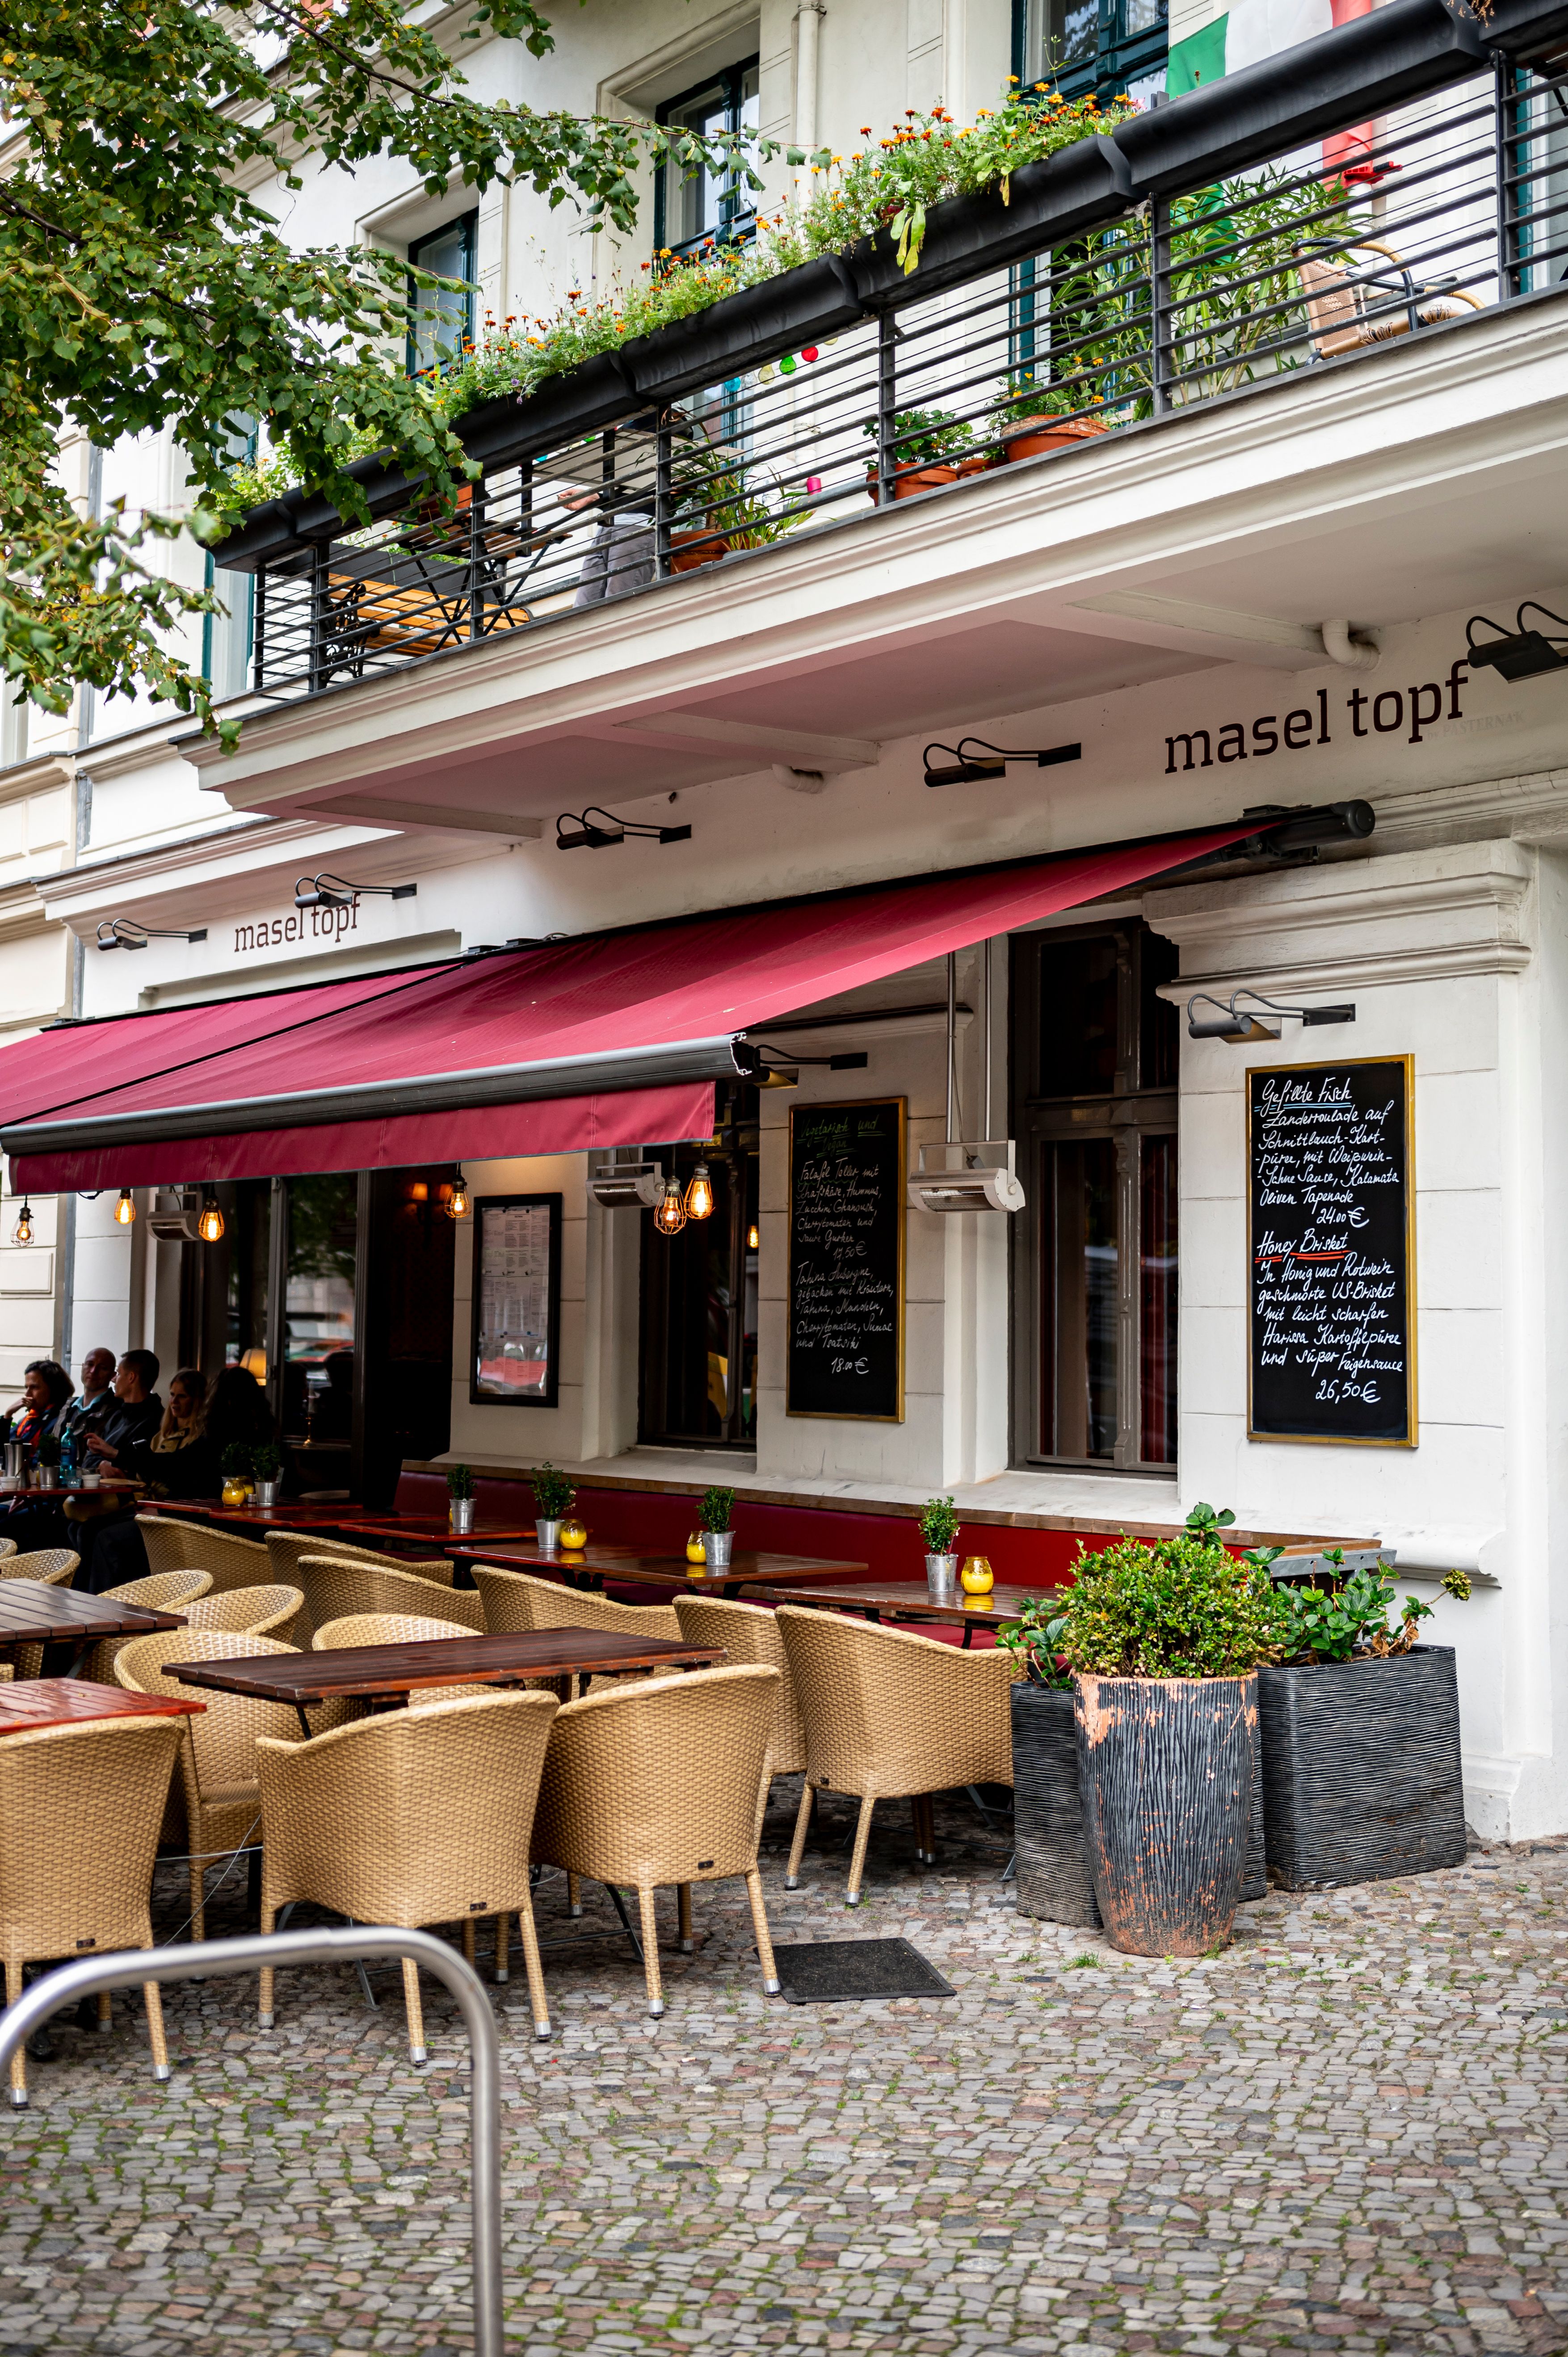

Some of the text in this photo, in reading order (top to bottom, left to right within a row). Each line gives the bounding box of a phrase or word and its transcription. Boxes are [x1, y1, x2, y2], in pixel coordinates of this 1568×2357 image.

[1164, 659, 1468, 774] masel topf
[235, 892, 361, 952] masel topf
[1260, 1077, 1352, 1117] Gefillte Fisch
[1262, 1100, 1394, 1128] Zanderroulade auf
[801, 1113, 880, 1148] Vegetarisch und
[822, 1136, 849, 1157] Vegan
[1303, 1150, 1324, 1164] mit
[800, 1157, 879, 1188] Falafel Teller mit
[1340, 1164, 1400, 1187] Kalamata
[795, 1200, 832, 1215] Zucchini
[1260, 1185, 1354, 1214] Oliven Tapenade
[797, 1216, 874, 1233] Cherrytomaten und
[825, 1229, 855, 1250] Gurken
[1257, 1228, 1349, 1263] Honey Brisket
[795, 1261, 826, 1286] Tahina
[1257, 1252, 1395, 1291] In Honig und Rotwein
[796, 1286, 834, 1309] gebacken
[838, 1287, 853, 1296] mit
[1257, 1281, 1396, 1315] geschmorte US-Brisket
[863, 1313, 893, 1332] Sumac
[1263, 1306, 1285, 1322] mit
[1292, 1303, 1327, 1322] leicht
[796, 1333, 862, 1349] und Tsatsiki
[1262, 1322, 1402, 1357] Harissa Kartoffelpüree
[1261, 1347, 1288, 1366] und
[1337, 1351, 1403, 1379] Feigensauce
